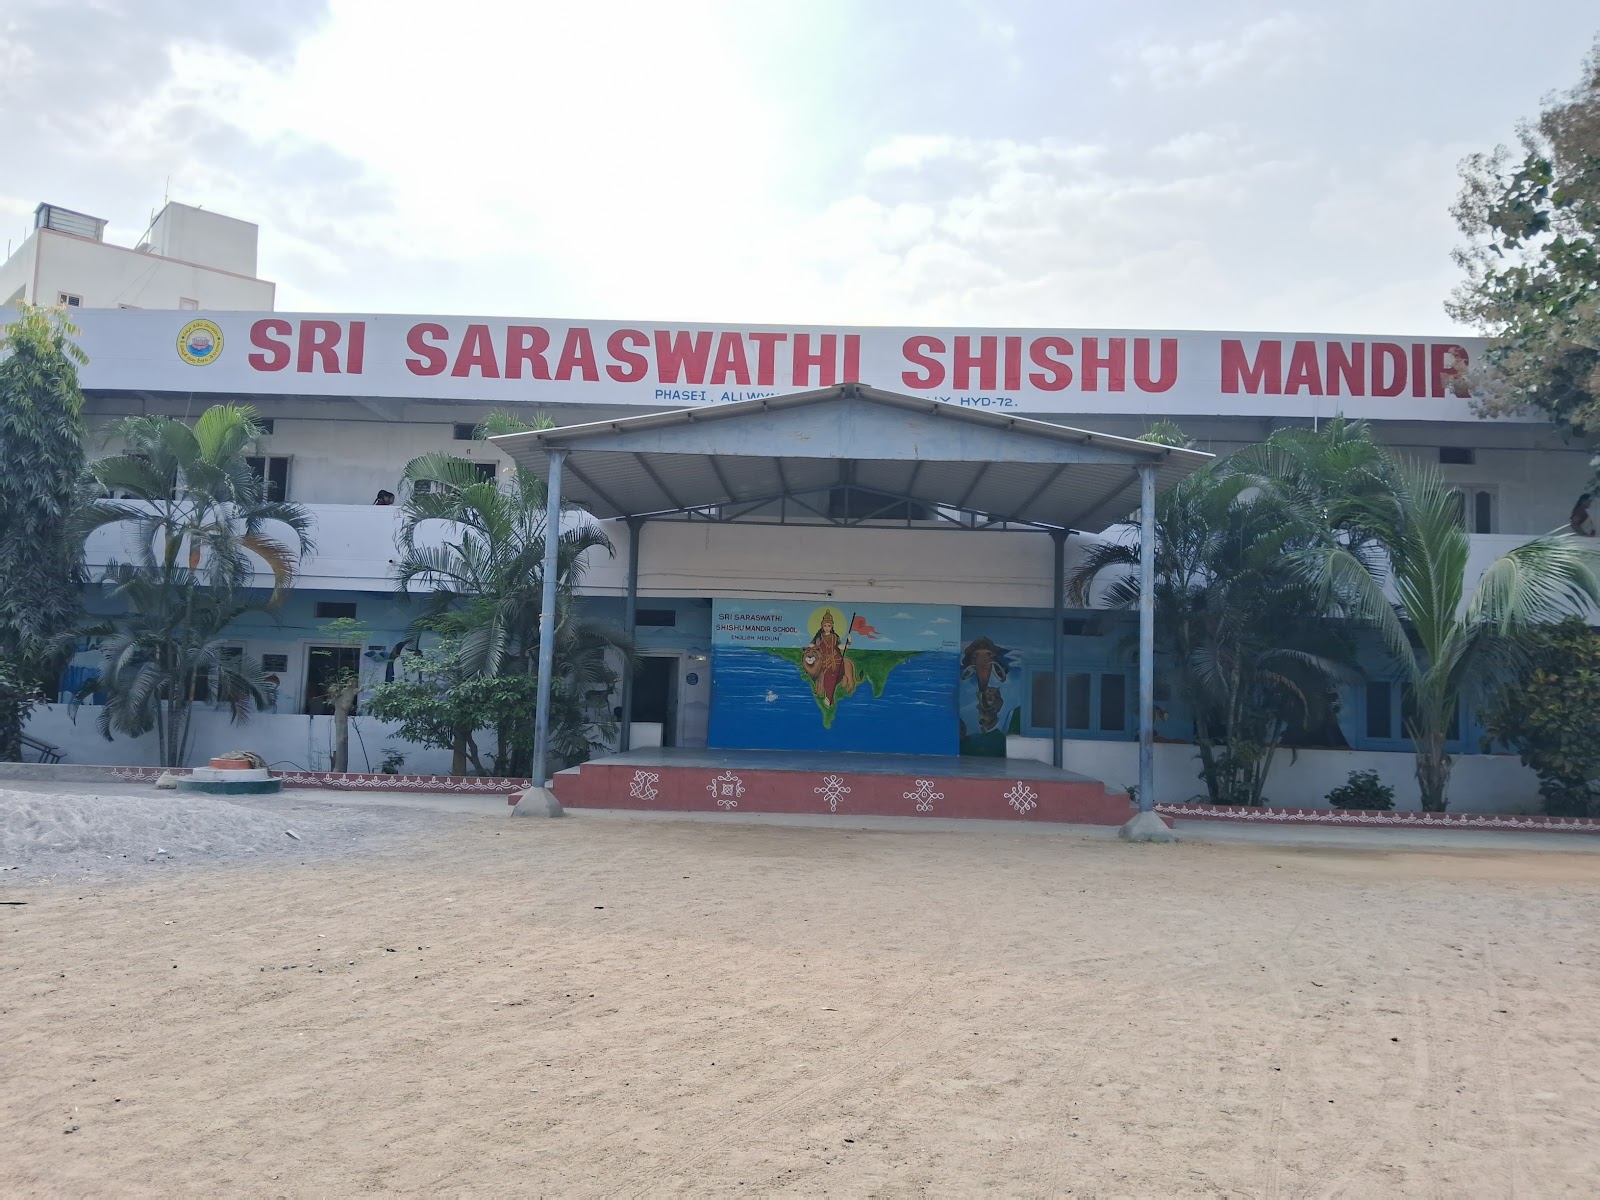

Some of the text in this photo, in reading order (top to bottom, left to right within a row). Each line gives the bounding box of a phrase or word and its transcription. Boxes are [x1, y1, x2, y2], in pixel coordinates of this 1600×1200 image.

[248, 318, 366, 375] SRI
[405, 322, 861, 387] SARASWATHI
[901, 335, 1178, 393] SHISHU
[1220, 339, 1472, 399] MANDIR
[734, 614, 783, 622] SARASWATHI
